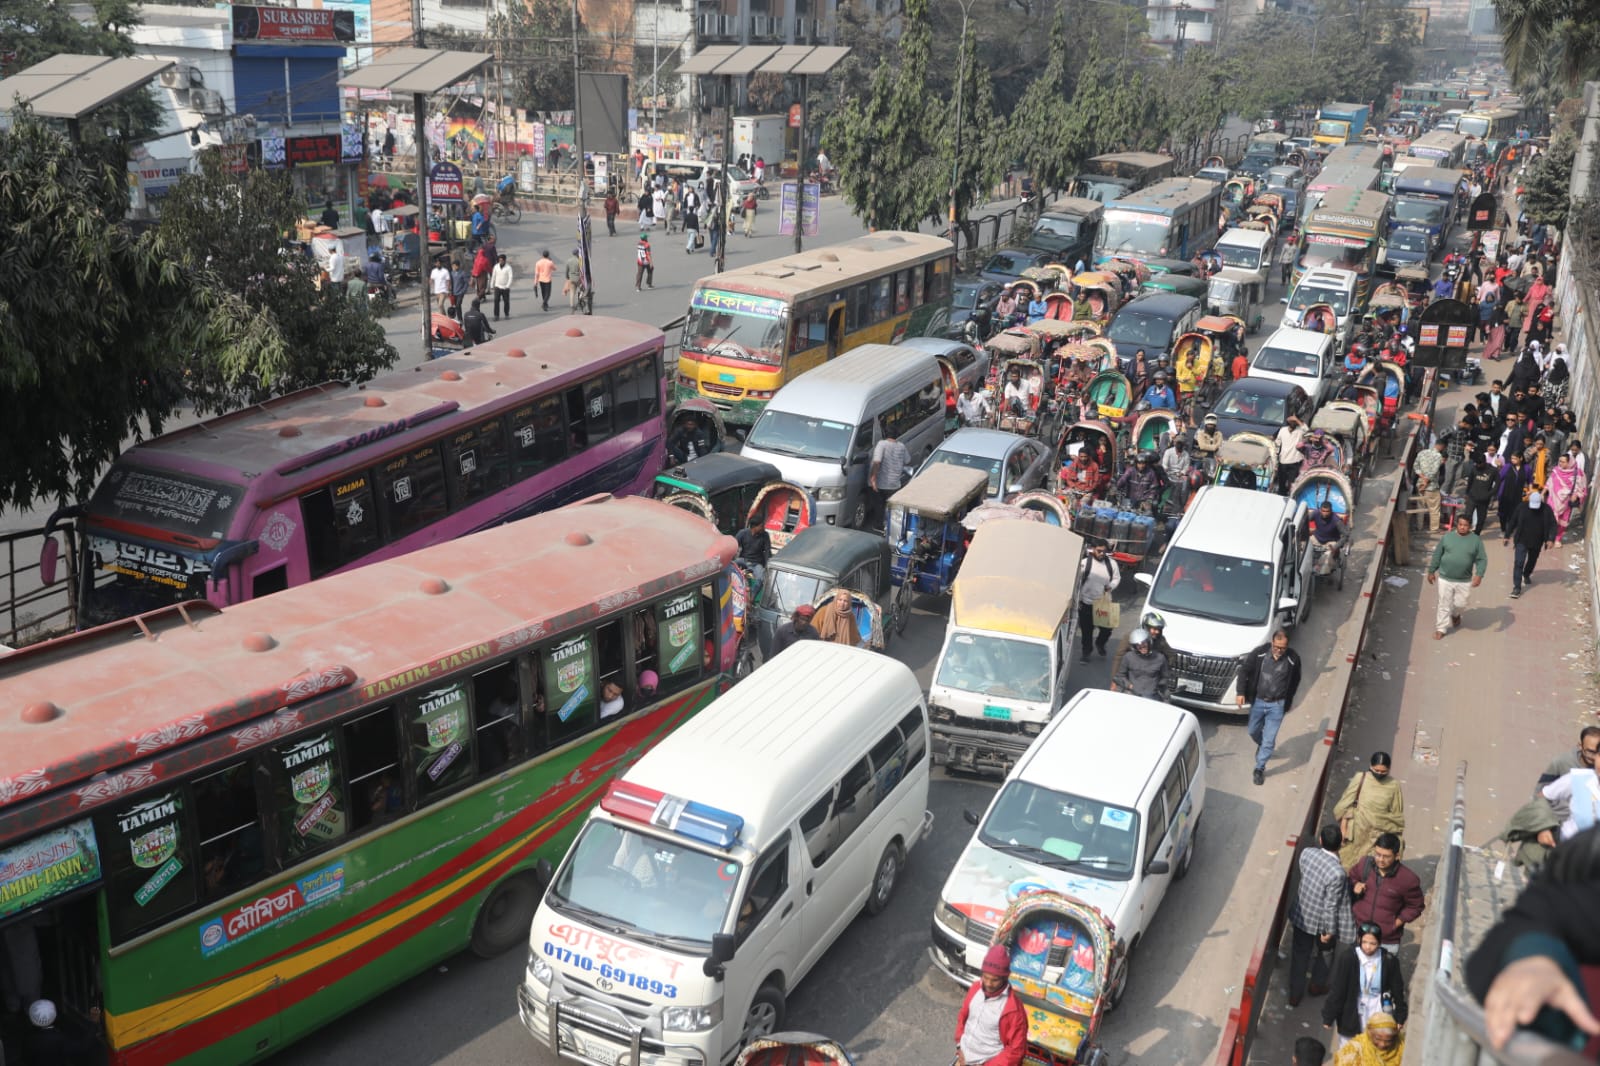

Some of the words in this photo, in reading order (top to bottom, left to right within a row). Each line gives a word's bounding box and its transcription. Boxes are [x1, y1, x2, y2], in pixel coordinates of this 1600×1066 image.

[263, 10, 329, 25] SURASREE
[704, 289, 757, 313] বিকাশ
[336, 478, 366, 496] SAIMA
[664, 599, 695, 619] TAMIM
[551, 640, 587, 663] TAMIM
[363, 642, 491, 698] TAMIM-TASIN
[419, 690, 461, 715] TAMIM
[283, 741, 330, 769] TAMIM
[118, 801, 176, 833] TAMIM
[0, 856, 81, 904] AMIM-TASIN
[228, 889, 296, 935] মৌমিতা
[543, 941, 678, 999] 01710-691893
